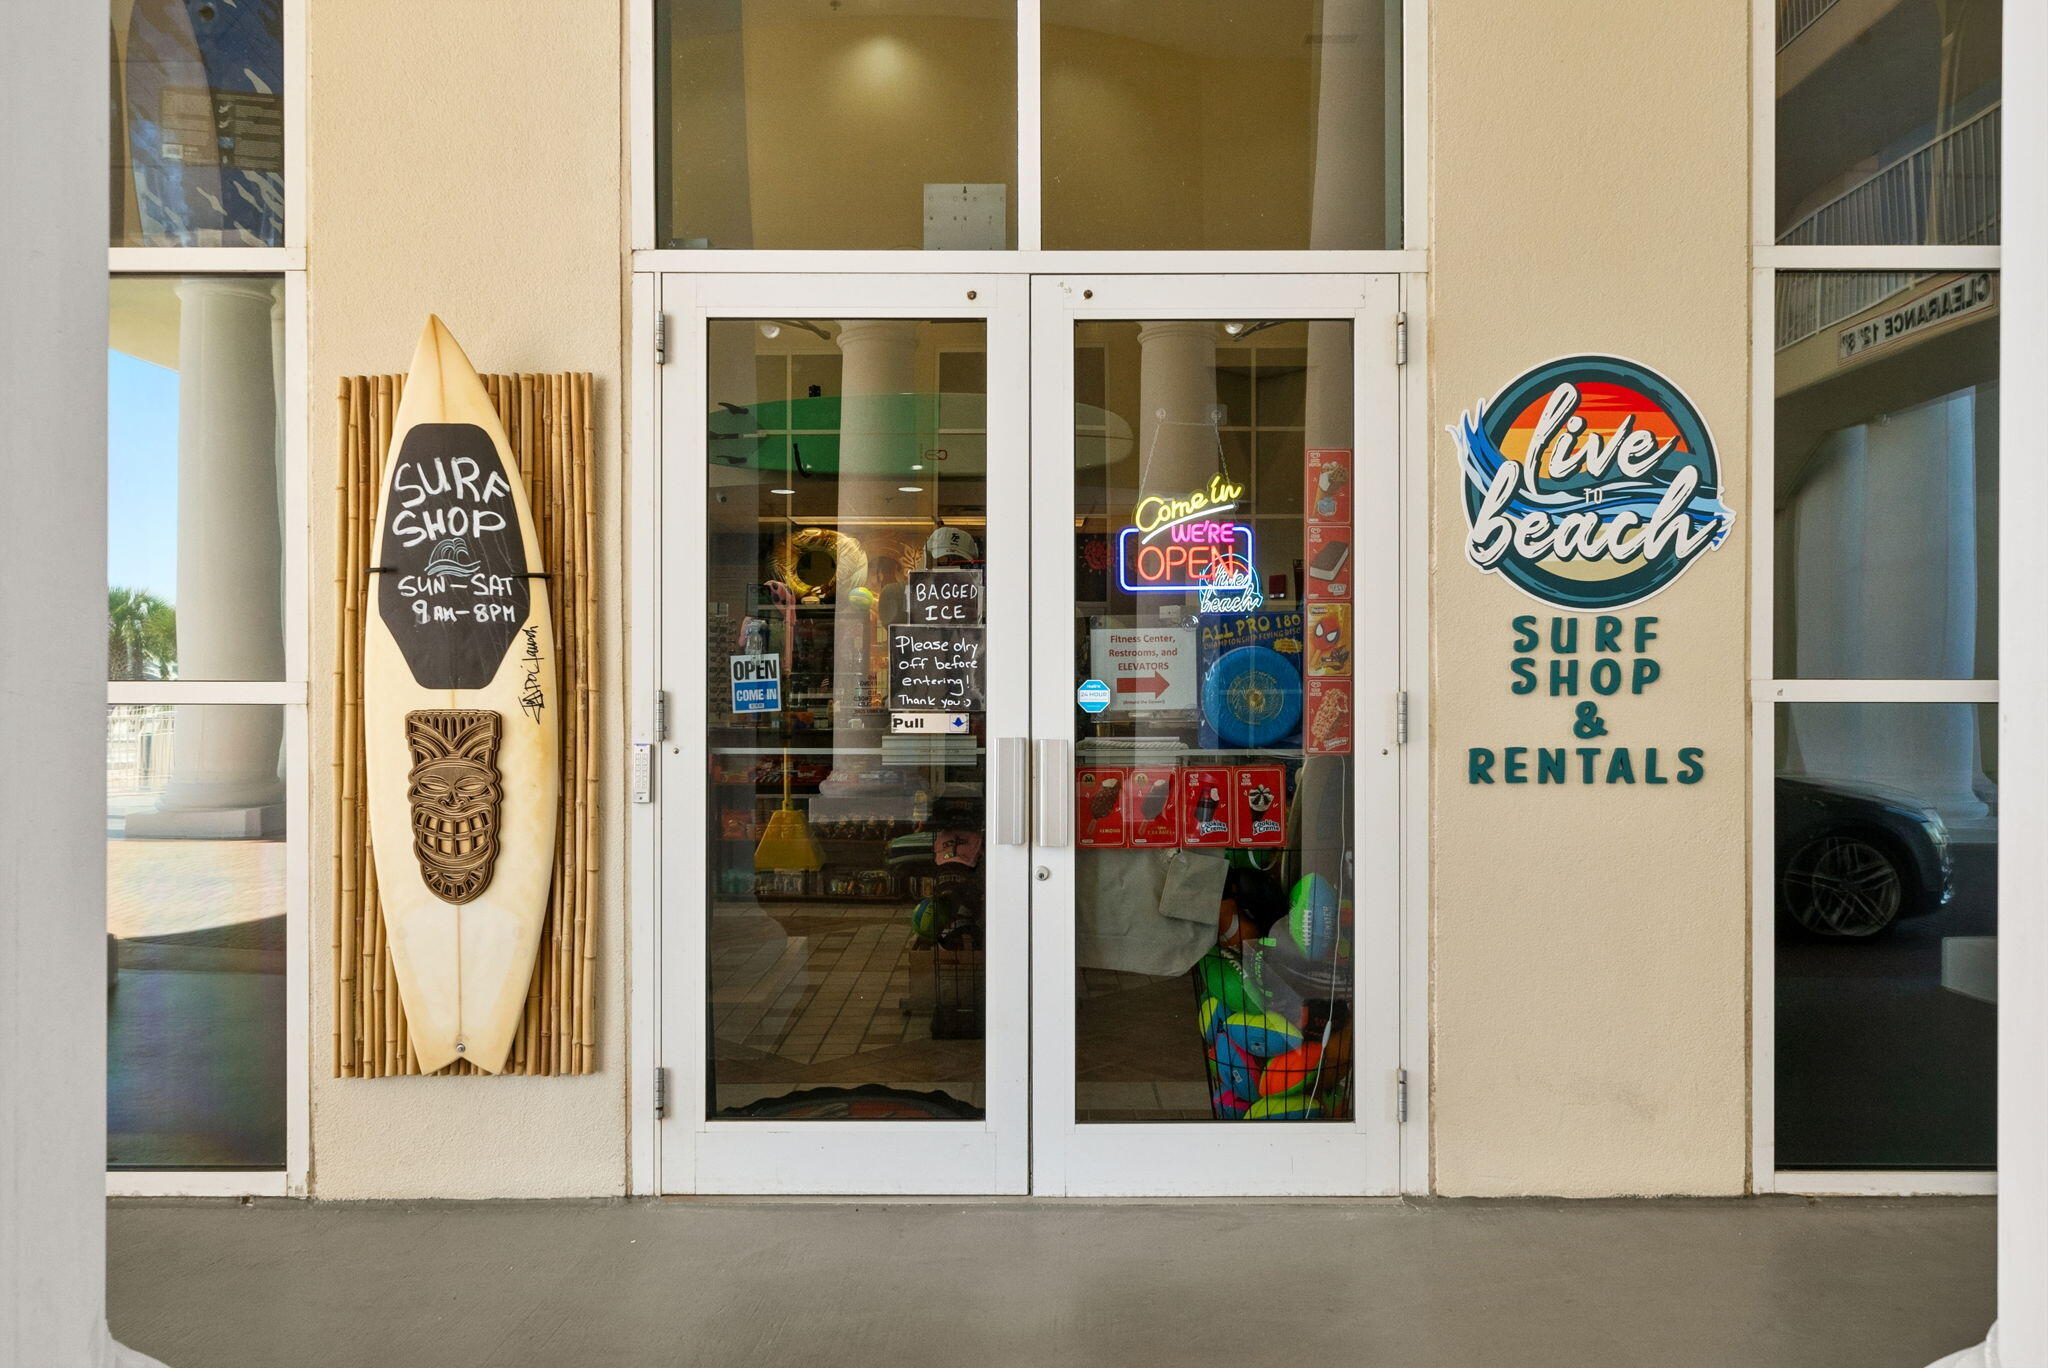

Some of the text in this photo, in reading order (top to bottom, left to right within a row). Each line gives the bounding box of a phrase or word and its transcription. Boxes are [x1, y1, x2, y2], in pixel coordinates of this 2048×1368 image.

[1524, 382, 1681, 495] live
[394, 457, 510, 508] SURF
[1135, 475, 1242, 532] Come in
[1583, 488, 1603, 504] TO
[1469, 460, 1719, 564] beach
[392, 507, 506, 547] SHOP
[1171, 520, 1235, 543] WE'RE
[1138, 544, 1235, 581] OPEN
[916, 583, 978, 601] BAGGED
[1200, 582, 1260, 614] beach
[925, 605, 966, 621] ICE
[1110, 635, 1176, 644] Fitness Center,
[1203, 623, 1234, 642] ALL
[1236, 616, 1270, 636] PRO
[1512, 615, 1659, 654] SURF
[895, 635, 978, 659] Please dry
[1108, 648, 1178, 658] Restrooms, and
[733, 660, 778, 681] OPEN
[899, 655, 978, 670] off before
[1118, 662, 1170, 671] ELEVATORS
[902, 675, 971, 696] entering!
[1511, 657, 1661, 697] SHOP
[736, 688, 777, 701] COME IN
[898, 694, 936, 705] Thank
[893, 719, 924, 729] Pull
[1573, 701, 1608, 739] &
[1468, 746, 1705, 785] RENTALS
